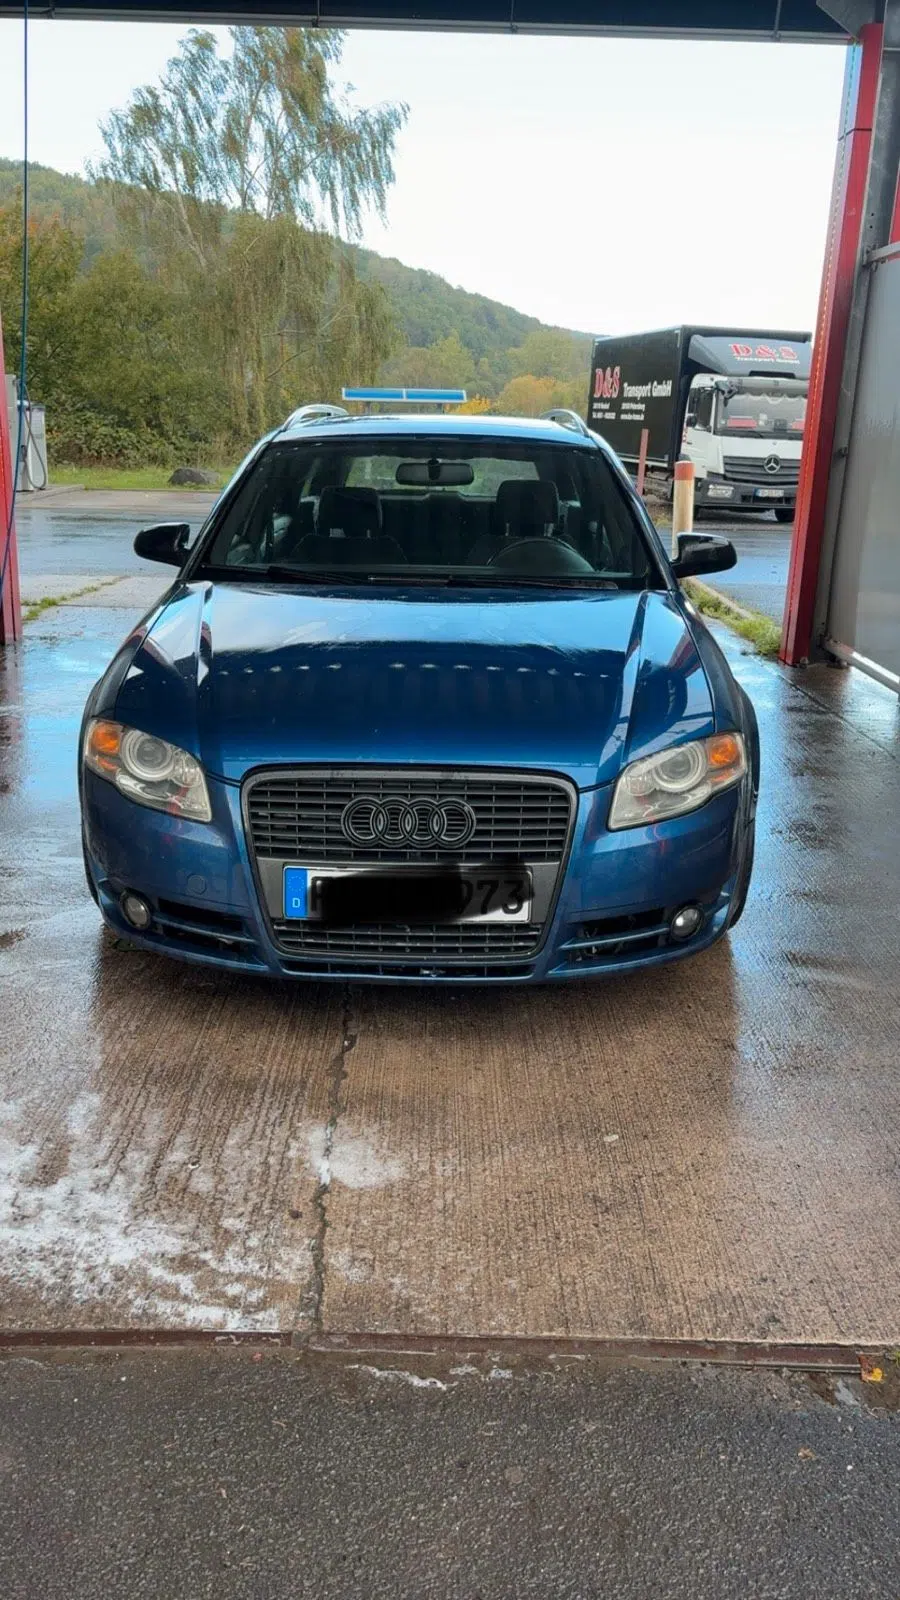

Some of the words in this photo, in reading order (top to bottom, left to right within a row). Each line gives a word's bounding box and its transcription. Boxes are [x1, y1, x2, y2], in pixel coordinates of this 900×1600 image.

[623, 381, 651, 400] Transport
[652, 380, 672, 397] GmbH
[292, 897, 301, 909] D
